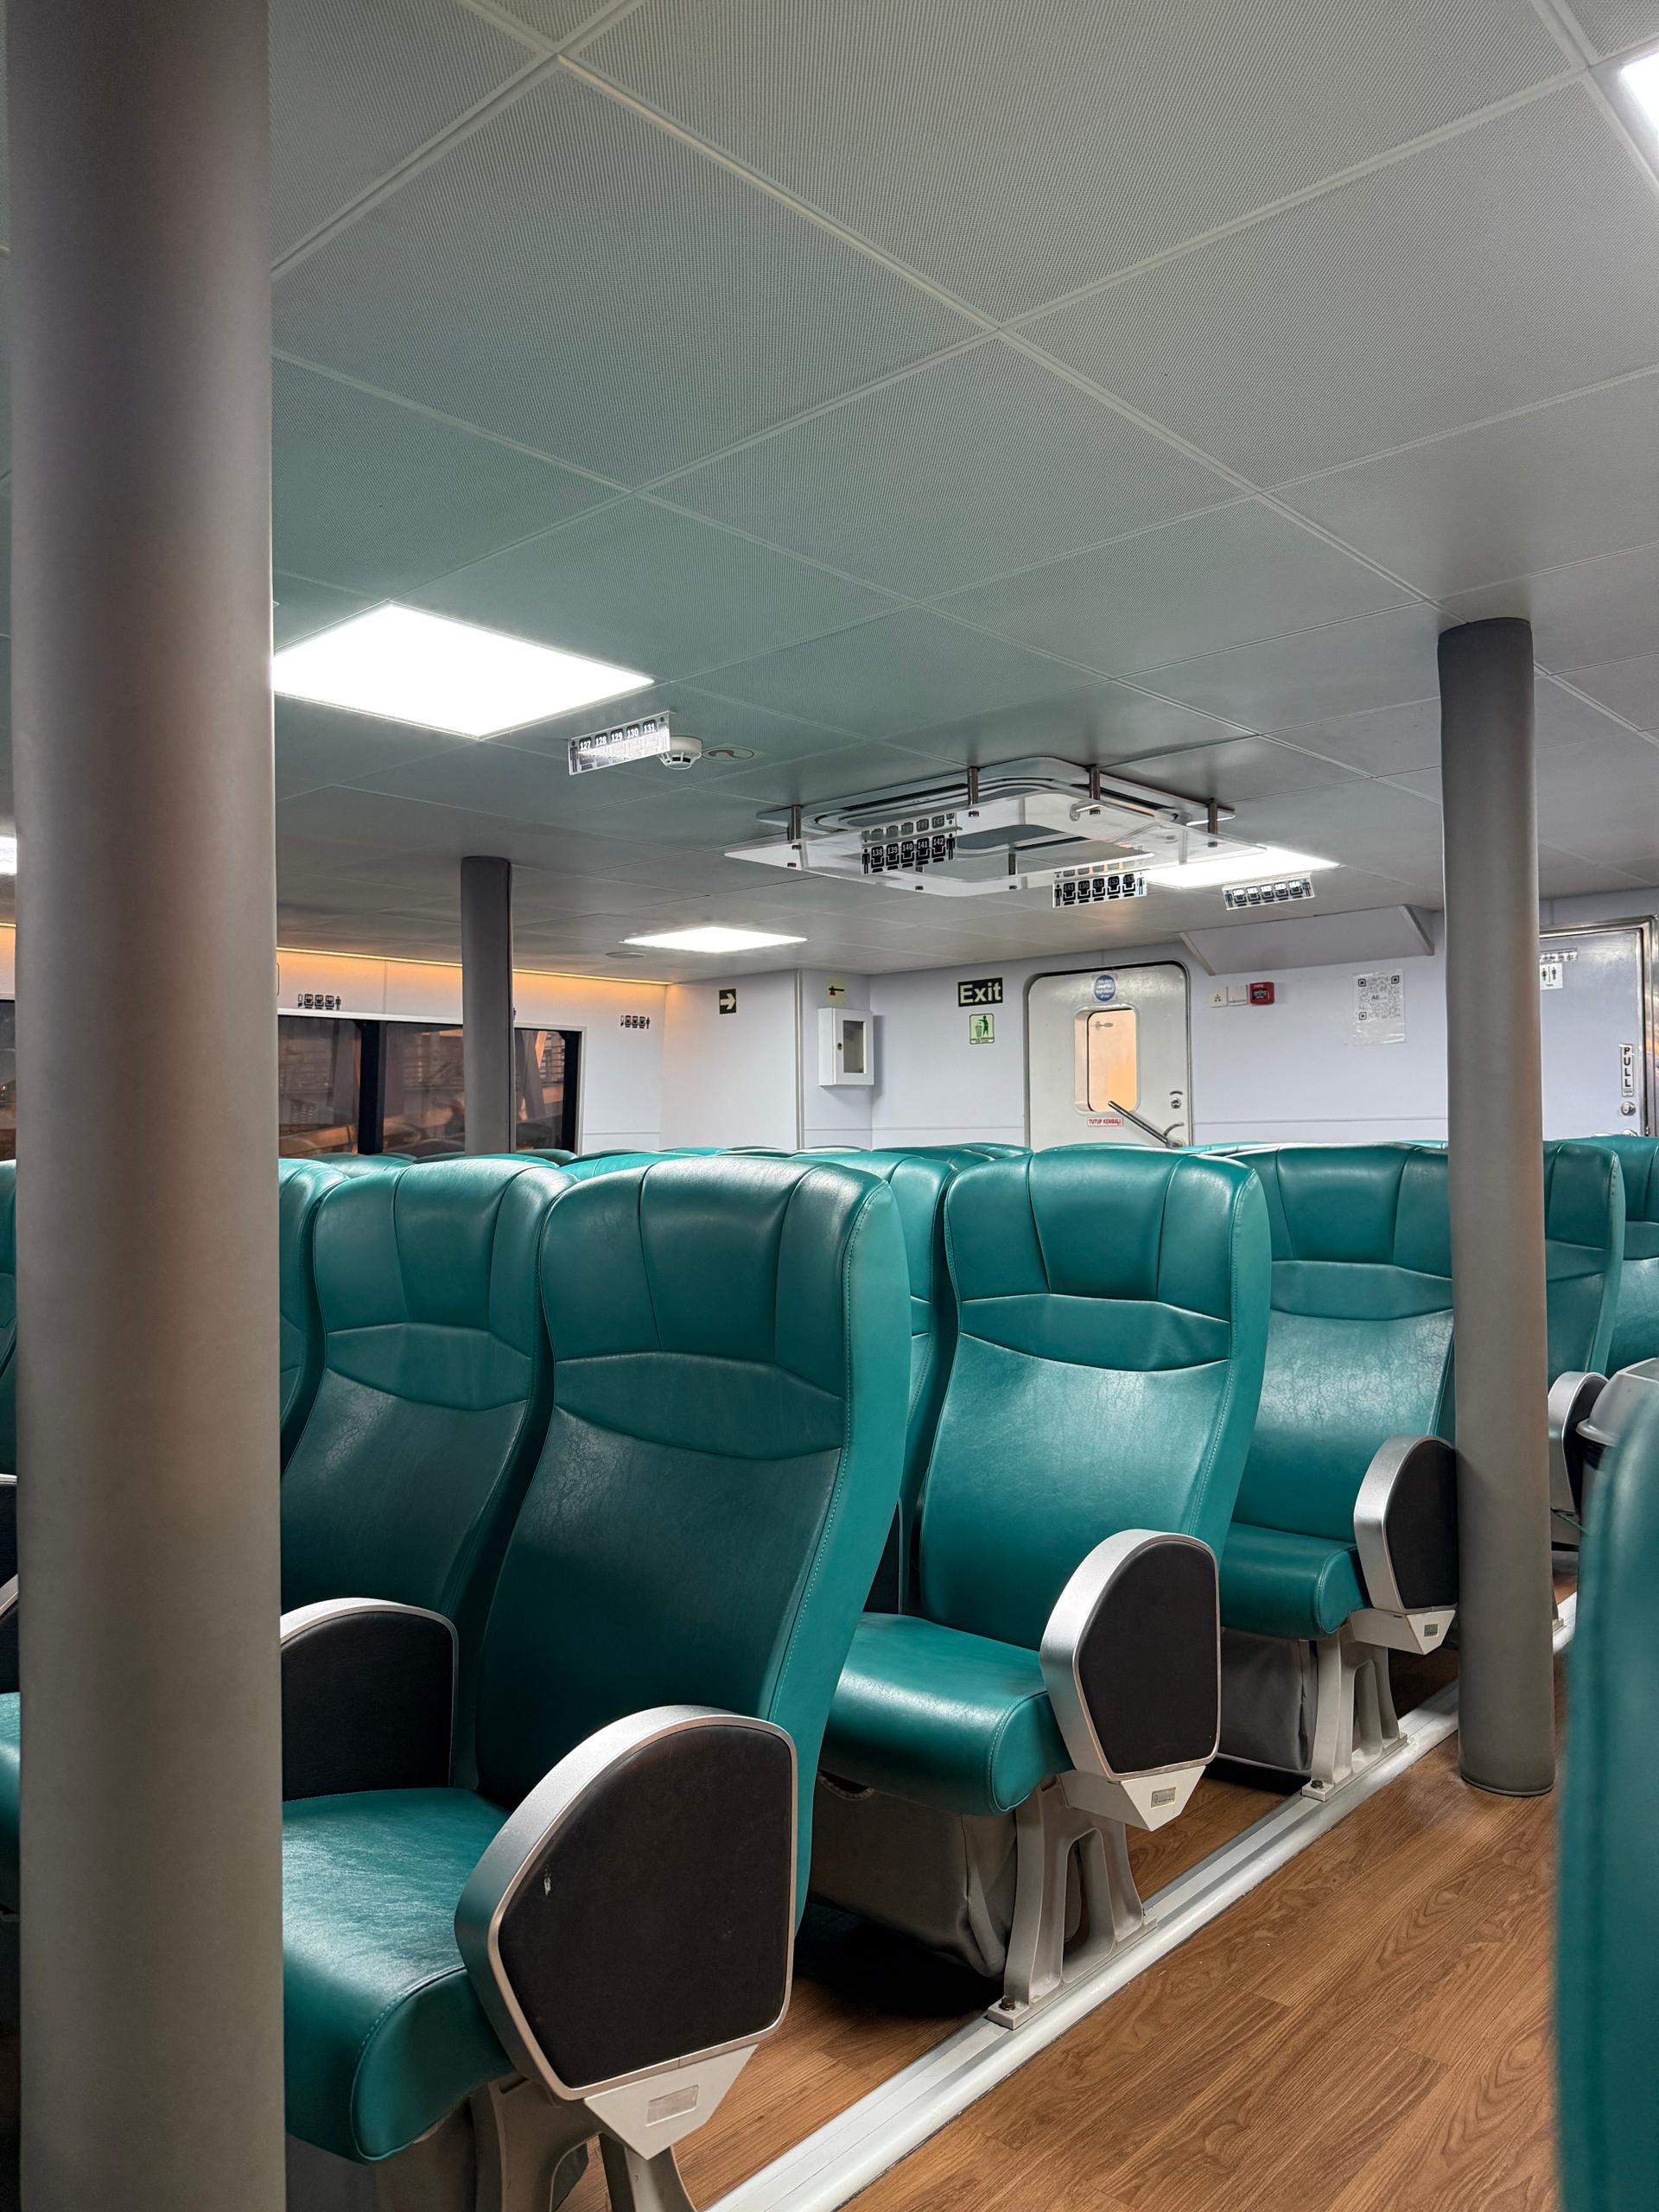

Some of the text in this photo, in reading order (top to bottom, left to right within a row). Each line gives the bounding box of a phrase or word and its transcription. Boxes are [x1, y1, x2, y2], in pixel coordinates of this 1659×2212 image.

[580, 722, 655, 750] 127 128 129 130 131
[872, 837, 944, 856] 138 139 140 141 142
[960, 982, 1001, 1004] Exit
